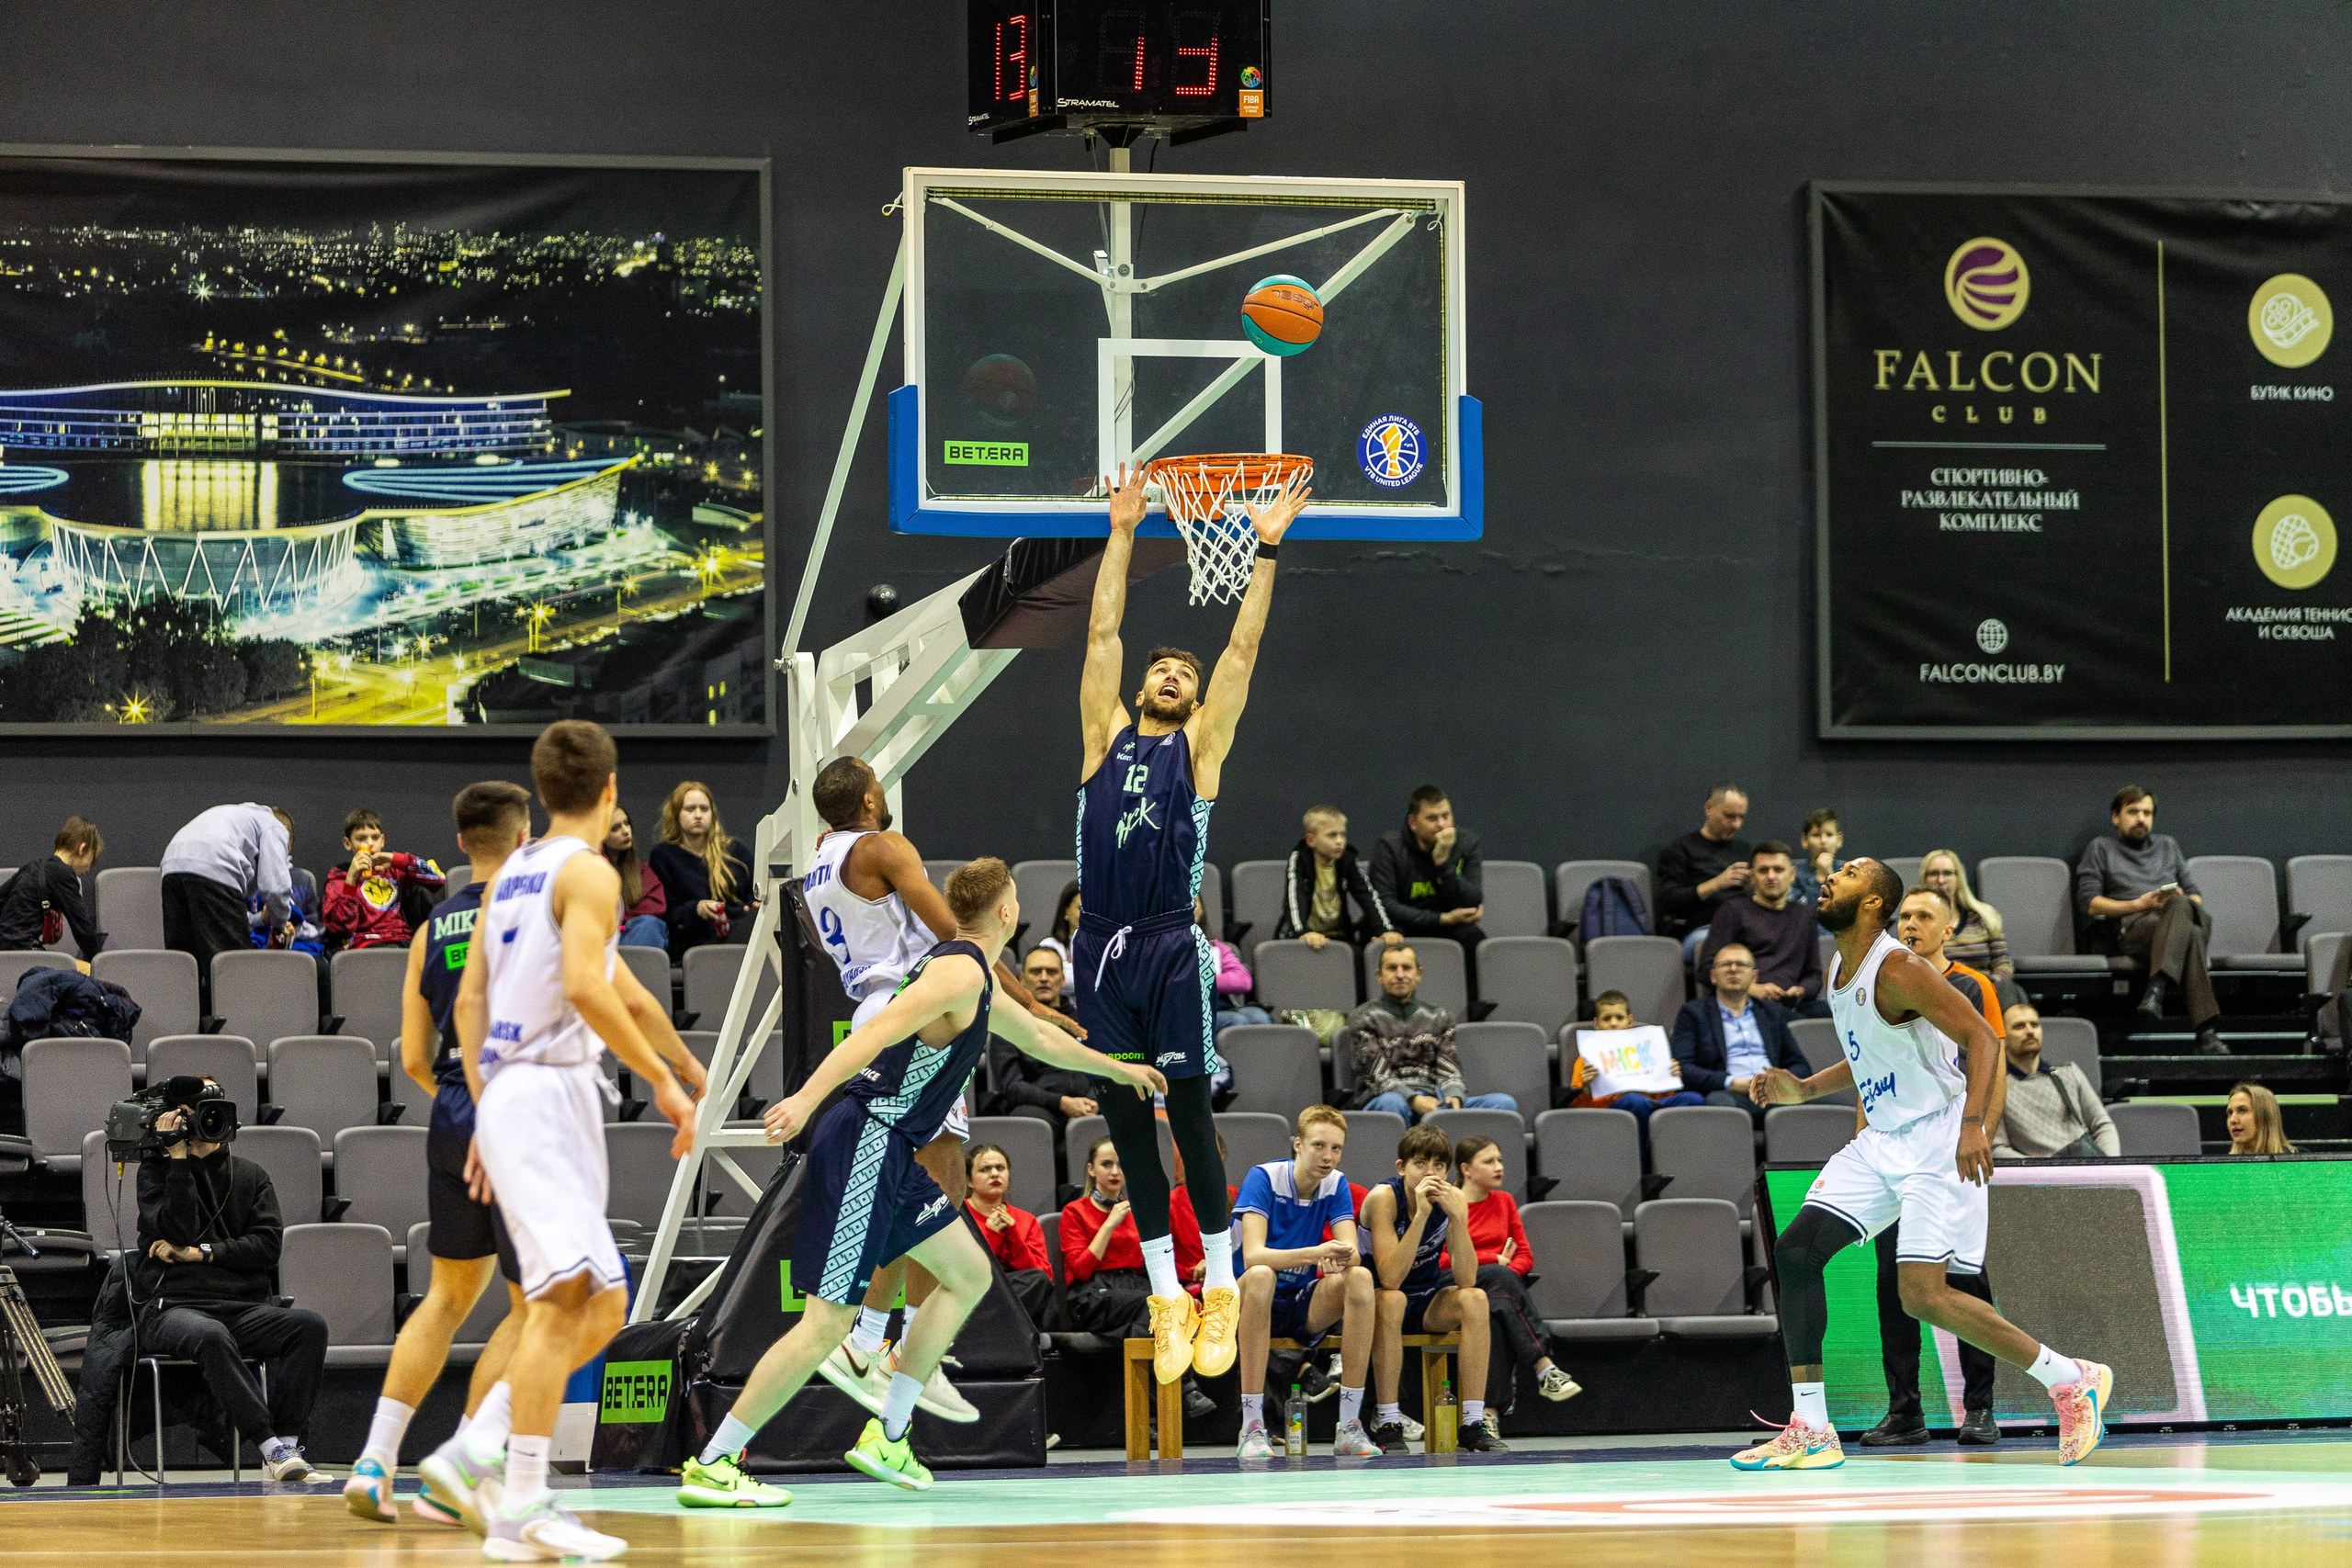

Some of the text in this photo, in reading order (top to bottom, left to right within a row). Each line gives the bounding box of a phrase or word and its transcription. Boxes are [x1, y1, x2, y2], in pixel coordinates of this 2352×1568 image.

[1057, 97, 1120, 108] STRAMATEL
[1243, 95, 1259, 103] FIBA
[1873, 349, 2104, 394] FALCON
[2250, 385, 2334, 401] БУТИК КИНО
[1931, 405, 2048, 424] CLUB
[1362, 415, 1420, 439] ЕДИНАЯ ЛИГА ВТБ
[1364, 462, 1423, 488] VTB UNITED LEAGUE
[1930, 467, 2050, 488] СПОРТИВНО-
[1901, 489, 2081, 511] РАЗВЛЕКАТЕЛЬНЫЙ
[1939, 513, 2044, 533] КОМПЛЕКС
[2225, 606, 2301, 623] АКАДЕМИЯ
[2257, 625, 2335, 640] И СКВОША
[1919, 663, 2066, 683] FALCONCLUB.BY
[1123, 763, 1148, 794] 12
[434, 908, 481, 941] MIK
[1848, 1030, 1860, 1062] 5
[605, 1374, 668, 1409] BETERA
